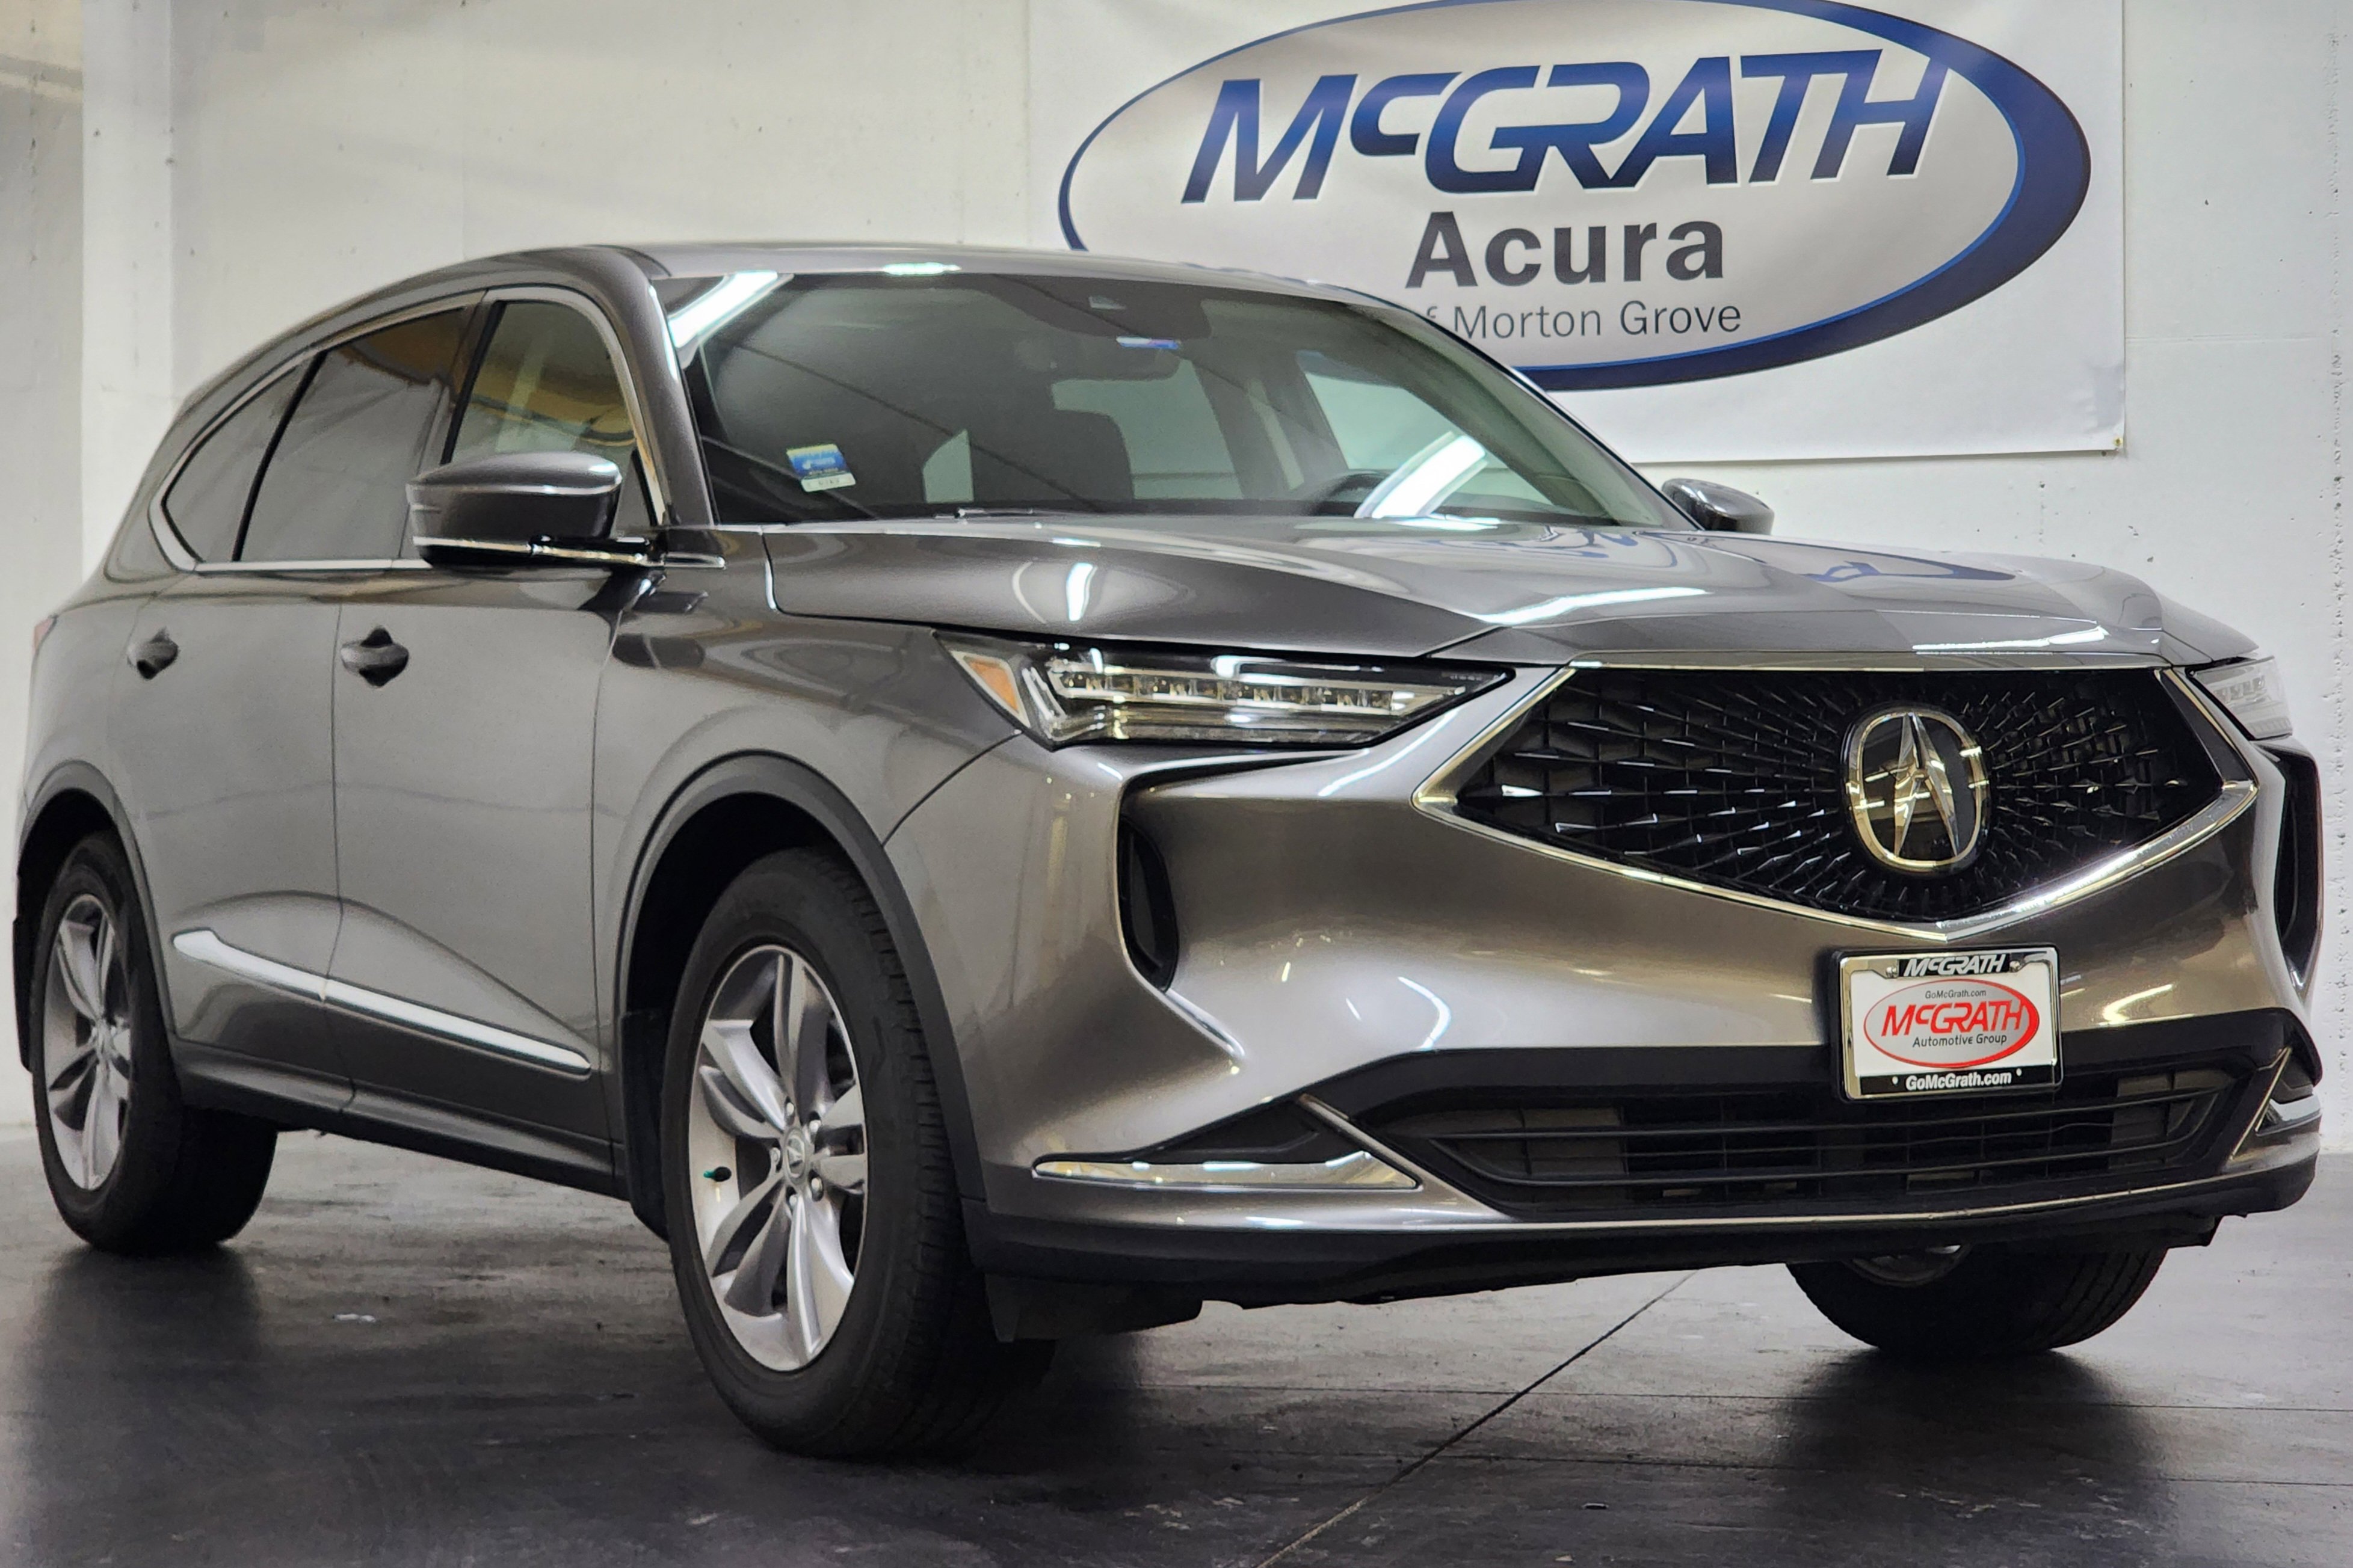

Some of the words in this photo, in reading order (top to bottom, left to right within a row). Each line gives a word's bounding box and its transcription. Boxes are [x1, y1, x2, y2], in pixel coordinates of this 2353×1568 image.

[1405, 211, 1723, 289] Acura
[1454, 304, 1602, 339] Morton
[1620, 300, 1742, 334] Grove
[1925, 989, 1987, 999] GoMcGrath.com
[1912, 1036, 1973, 1048] Automotive
[1976, 1033, 2007, 1046] Group
[1905, 1072, 2012, 1091] GoMcGrath.com
